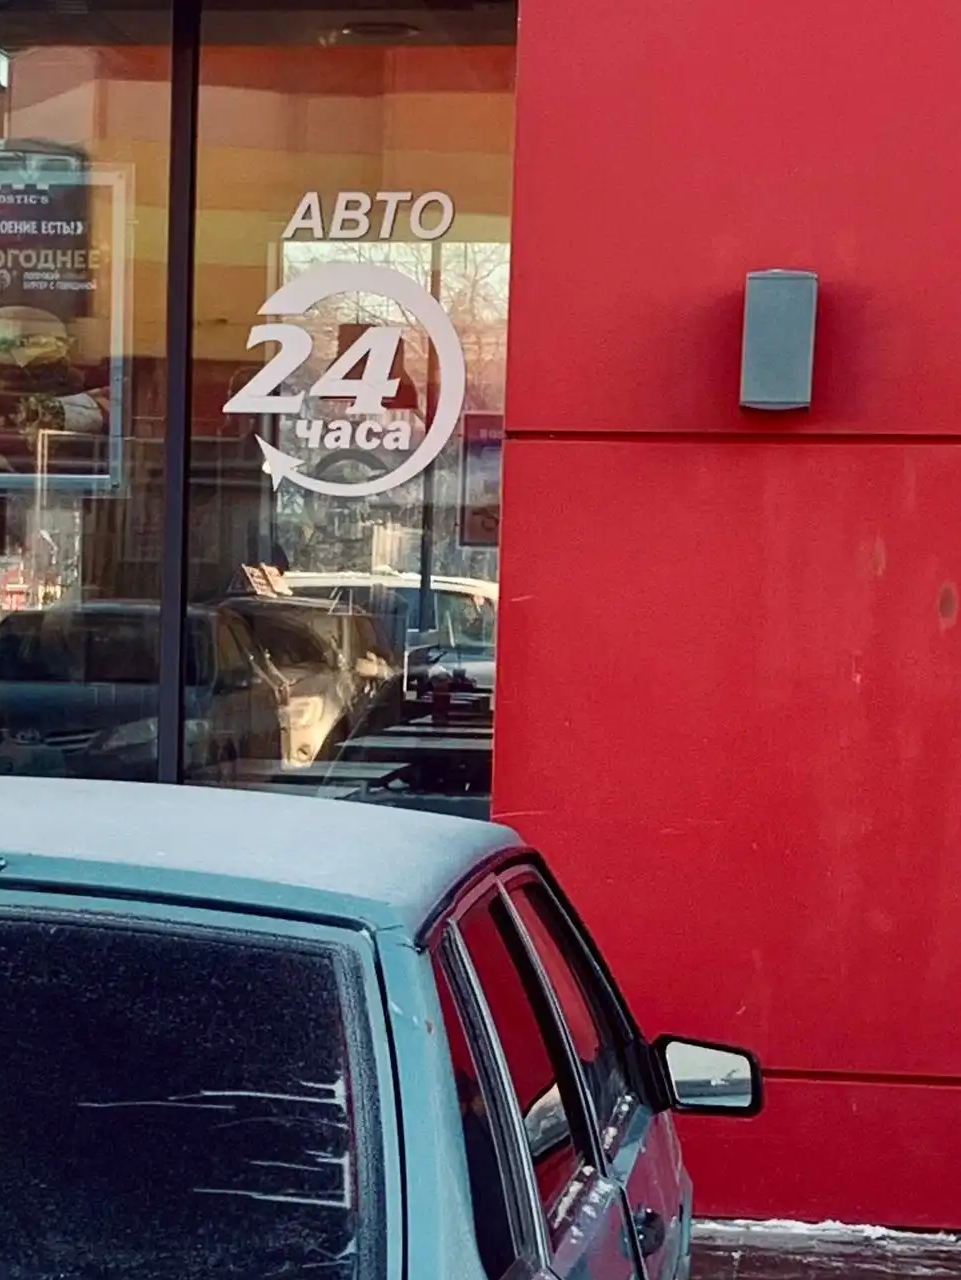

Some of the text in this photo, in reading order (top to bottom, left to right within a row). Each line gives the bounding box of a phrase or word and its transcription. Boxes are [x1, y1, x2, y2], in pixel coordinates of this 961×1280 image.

[281, 191, 455, 240] АВТО
[222, 323, 404, 414] 24
[295, 419, 411, 449] часа
